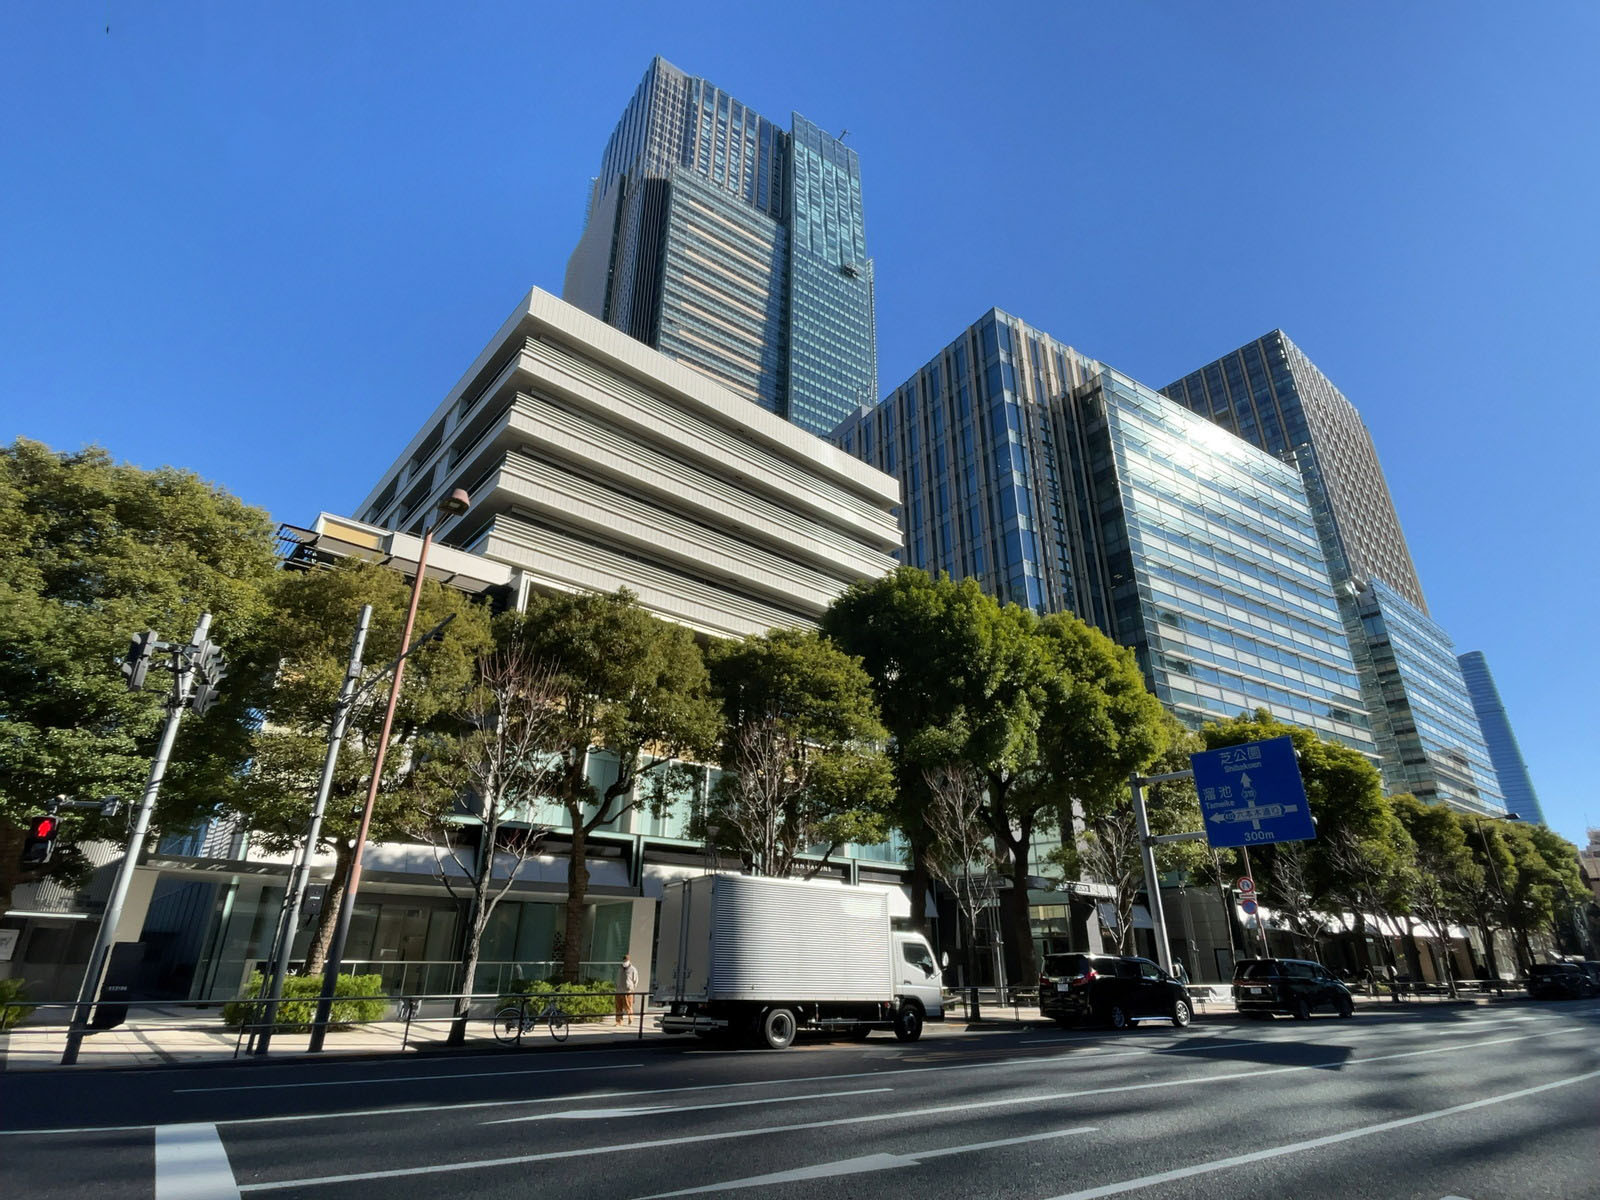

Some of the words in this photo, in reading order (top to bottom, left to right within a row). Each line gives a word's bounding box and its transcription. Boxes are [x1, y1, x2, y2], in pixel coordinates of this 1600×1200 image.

[1218, 745, 1262, 765] 芝公園
[1244, 830, 1274, 841] 300m
